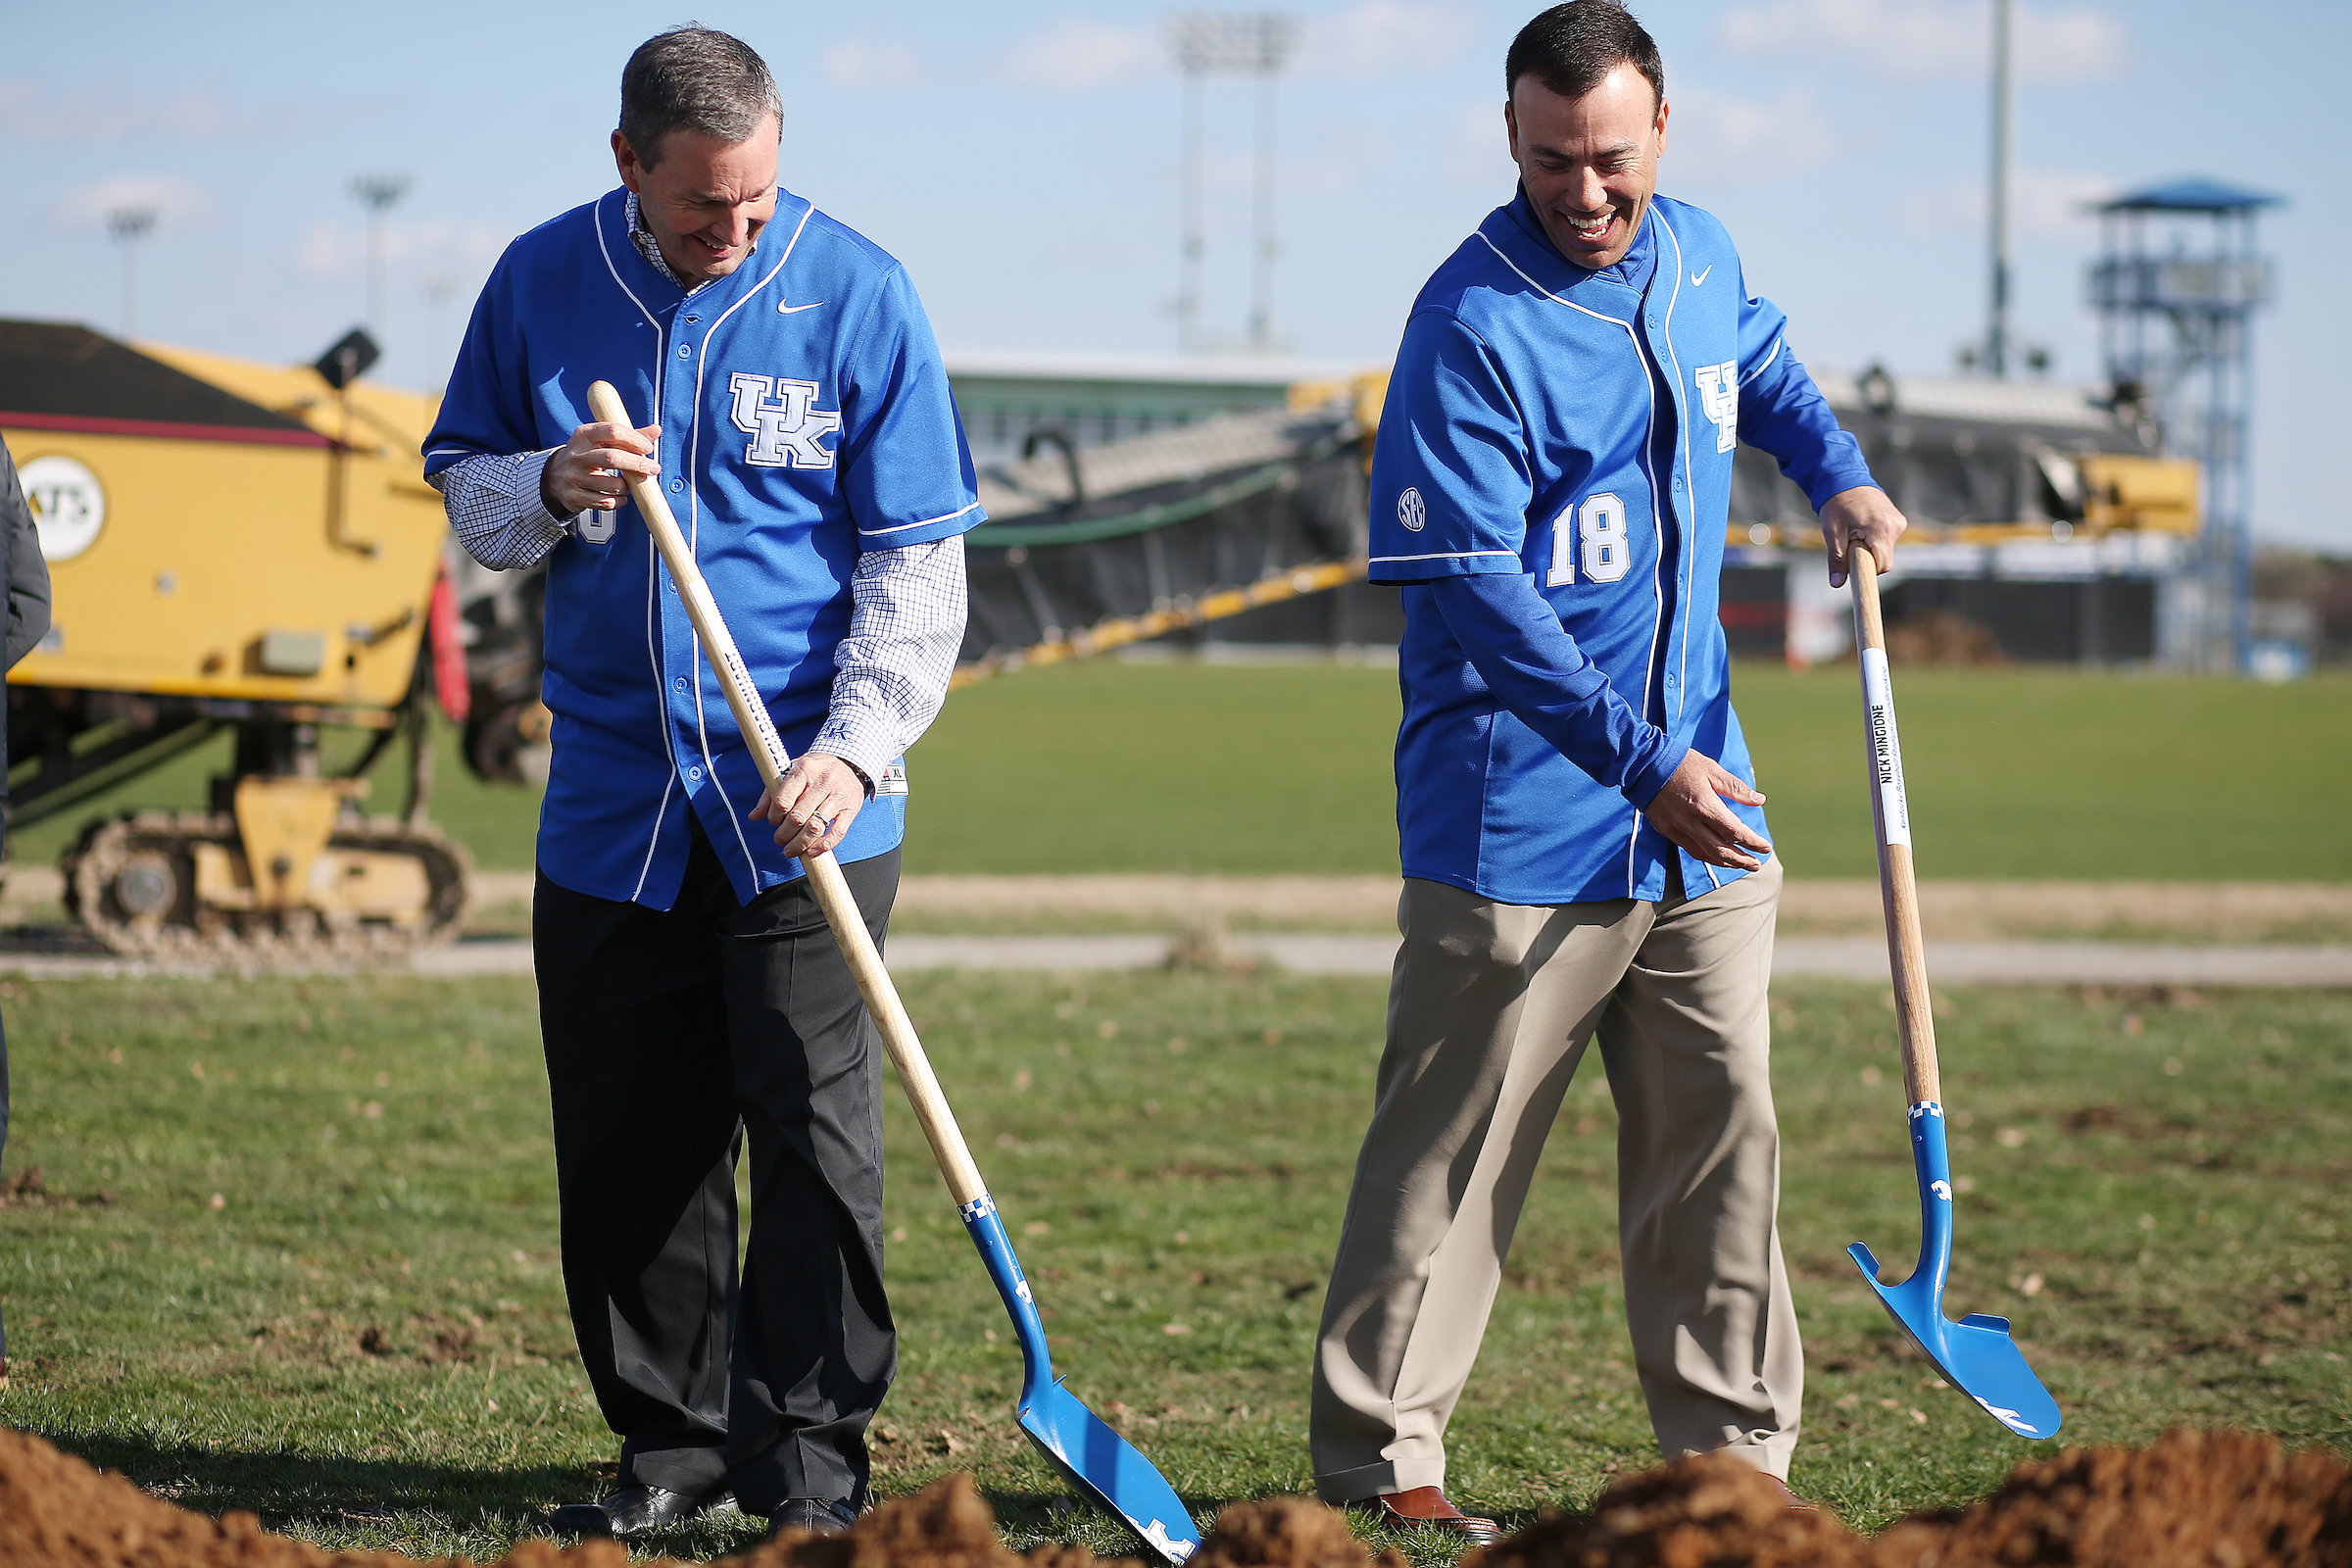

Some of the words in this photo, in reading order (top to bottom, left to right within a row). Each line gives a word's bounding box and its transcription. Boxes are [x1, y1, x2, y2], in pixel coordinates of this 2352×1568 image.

[728, 371, 842, 470] UK
[1400, 489, 1423, 529] SEC
[1546, 492, 1632, 588] 18
[724, 652, 770, 733] BARNHART
[1882, 665, 1894, 725] Groundbreaking
[1871, 704, 1889, 757] MINGIONE
[1878, 759, 1893, 784] NICK
[1892, 758, 1903, 793] Baseball
[1898, 793, 1907, 830] Kentucky
